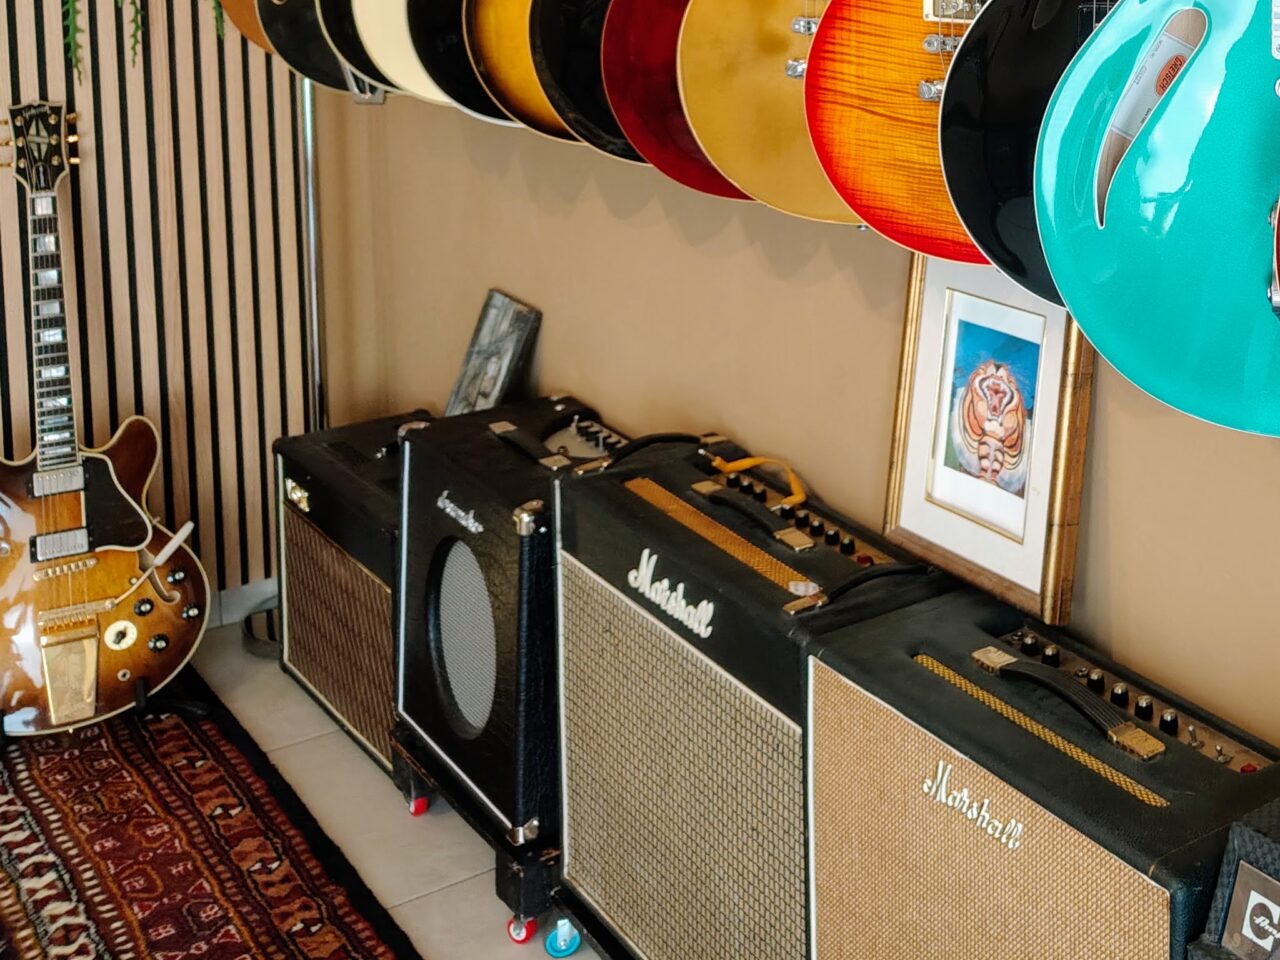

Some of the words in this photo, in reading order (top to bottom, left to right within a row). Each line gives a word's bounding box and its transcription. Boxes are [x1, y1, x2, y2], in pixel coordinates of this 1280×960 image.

[1160, 56, 1183, 91] GRETSCH
[627, 547, 716, 640] Marshall
[921, 758, 1024, 851] Marshall
